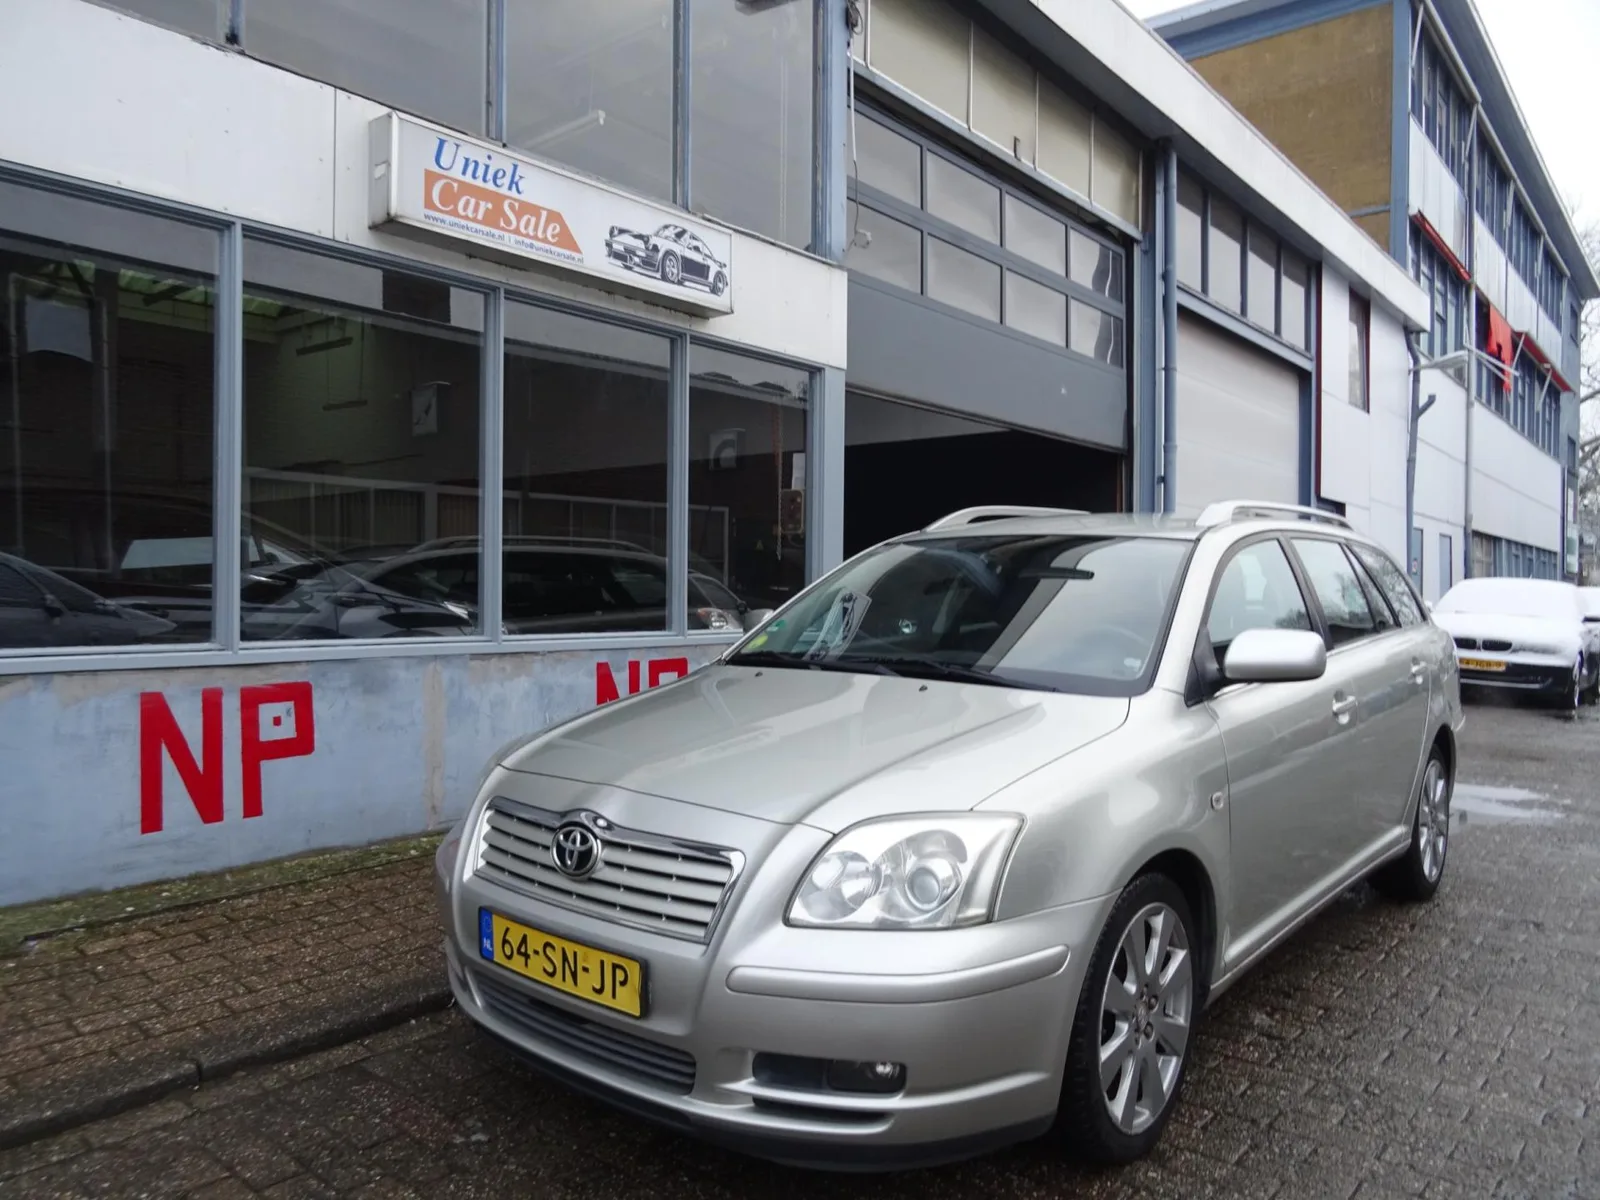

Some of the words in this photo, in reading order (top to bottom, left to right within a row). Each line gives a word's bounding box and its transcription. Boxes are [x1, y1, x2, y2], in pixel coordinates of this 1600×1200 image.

[434, 136, 525, 195] Uniek
[423, 212, 505, 242] www.uniekcarsale.nl
[514, 238, 585, 264] info@uniekcarsale.nl
[432, 178, 493, 221] Car
[500, 199, 561, 243] Sale
[139, 681, 315, 835] NP
[483, 937, 493, 952] NL
[501, 926, 629, 1000] 64-SN-JP
